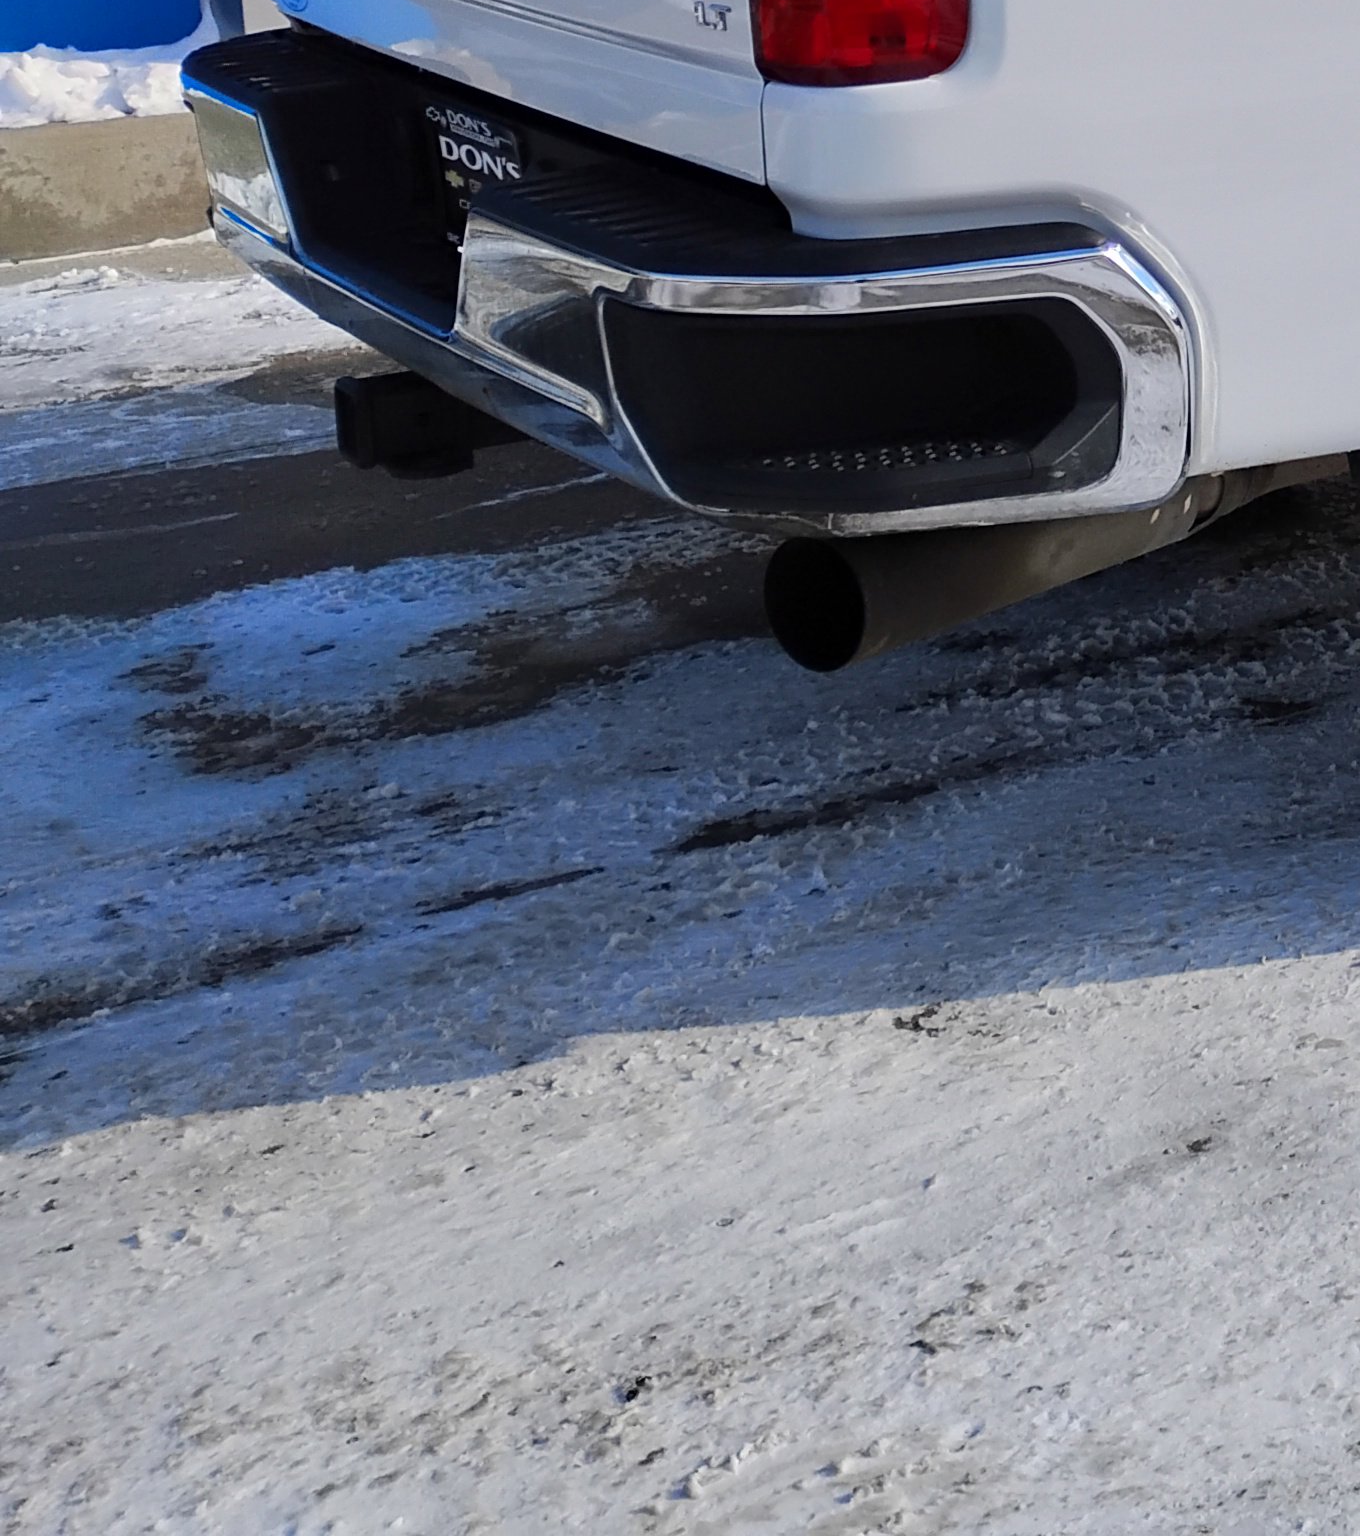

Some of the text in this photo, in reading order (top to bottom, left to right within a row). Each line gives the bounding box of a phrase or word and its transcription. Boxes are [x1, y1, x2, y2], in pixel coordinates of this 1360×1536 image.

[693, 0, 732, 32] LT
[445, 109, 492, 137] DON'S
[439, 135, 521, 181] DON'S
